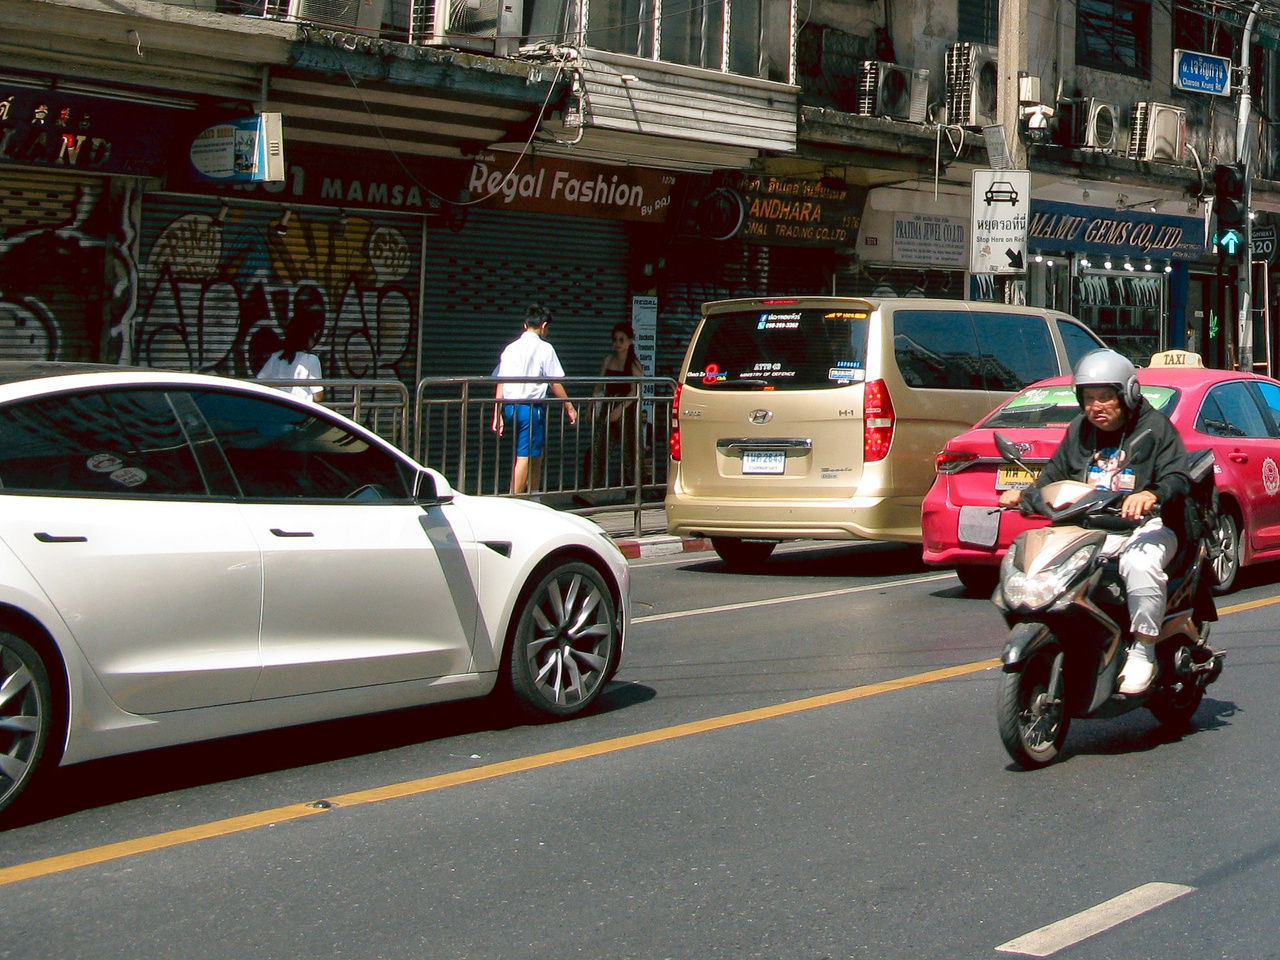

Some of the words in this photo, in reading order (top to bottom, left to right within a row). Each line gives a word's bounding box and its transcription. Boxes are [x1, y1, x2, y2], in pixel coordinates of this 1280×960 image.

[1182, 78, 1200, 87] Charoen
[1201, 81, 1214, 91] Krung
[320, 177, 423, 207] MAMSA
[468, 162, 545, 203] Regal
[551, 171, 644, 207] Fashion
[641, 205, 652, 216] By
[655, 195, 671, 210] RAJ
[746, 197, 821, 222] ANDHARA
[775, 224, 813, 238] TRADING
[896, 221, 921, 239] PRATIMA
[977, 213, 1026, 233] หยุดรอที่นี่
[1029, 212, 1086, 240] MAMU
[1085, 218, 1132, 245] GEMS
[1014, 235, 1025, 243] Red
[1164, 354, 1186, 365] TAXI
